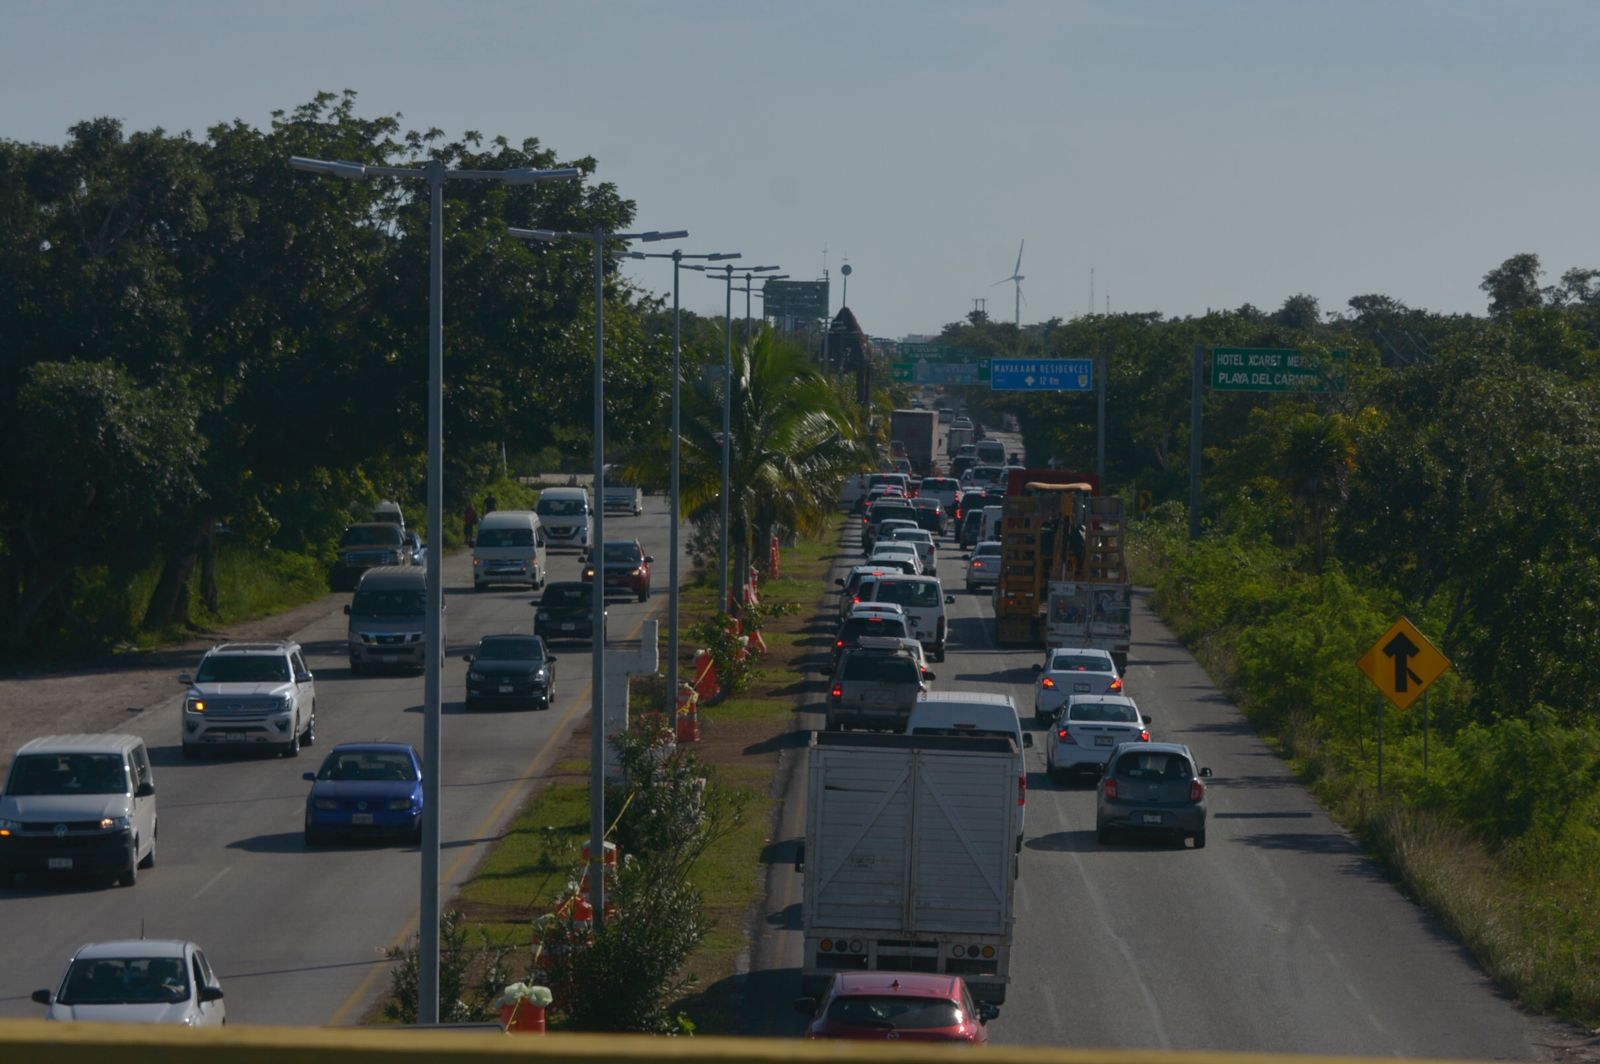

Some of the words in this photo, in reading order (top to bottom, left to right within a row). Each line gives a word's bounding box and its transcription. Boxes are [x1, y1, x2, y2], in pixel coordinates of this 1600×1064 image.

[1216, 354, 1244, 366] HOTEL
[1248, 354, 1282, 366] XCARET
[1040, 364, 1088, 373] RESIDENCES
[1039, 376, 1046, 385] 12
[1218, 372, 1249, 384] PLAYA
[1251, 373, 1272, 385] DEL
